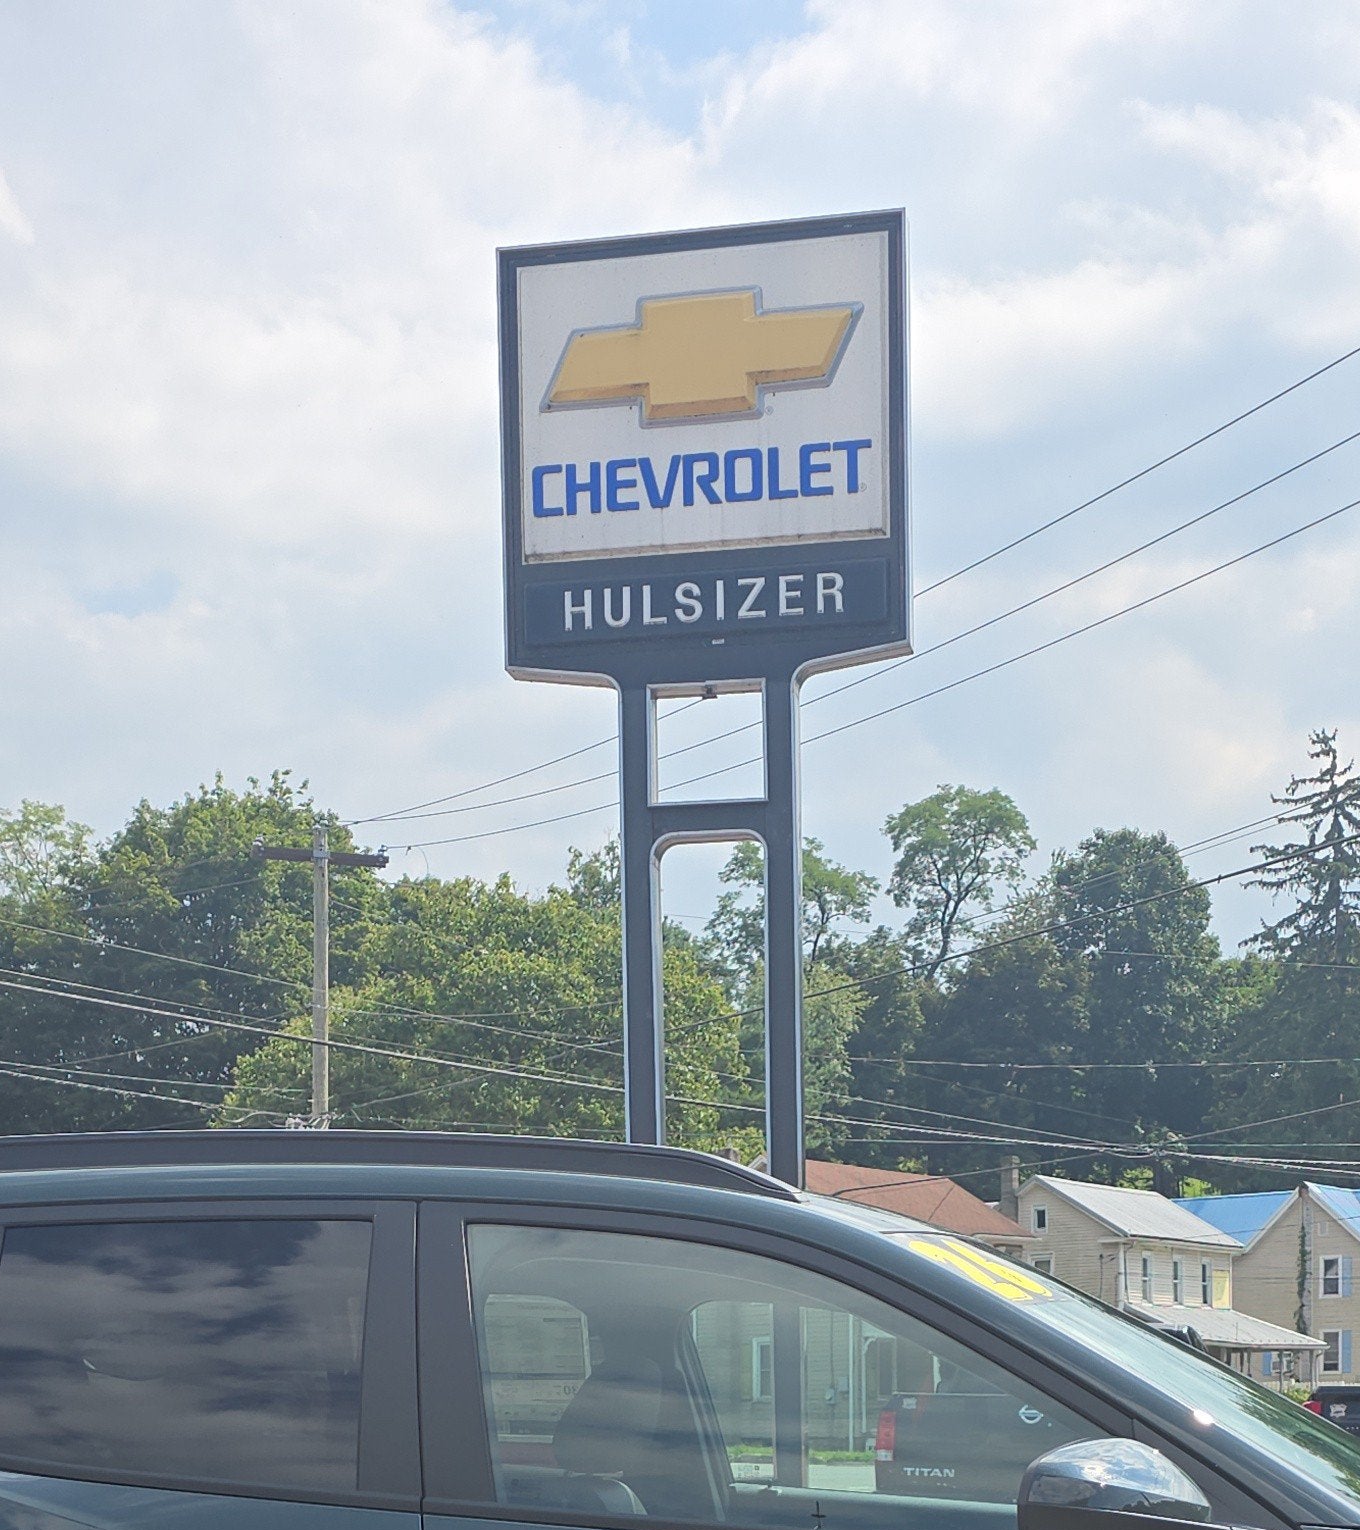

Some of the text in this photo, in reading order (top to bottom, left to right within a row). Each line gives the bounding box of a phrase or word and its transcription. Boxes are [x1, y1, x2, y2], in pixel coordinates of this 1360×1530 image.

[531, 438, 872, 518] CHEVROLET
[563, 571, 845, 632] HULSIZER
[903, 1467, 956, 1478] TITAN
